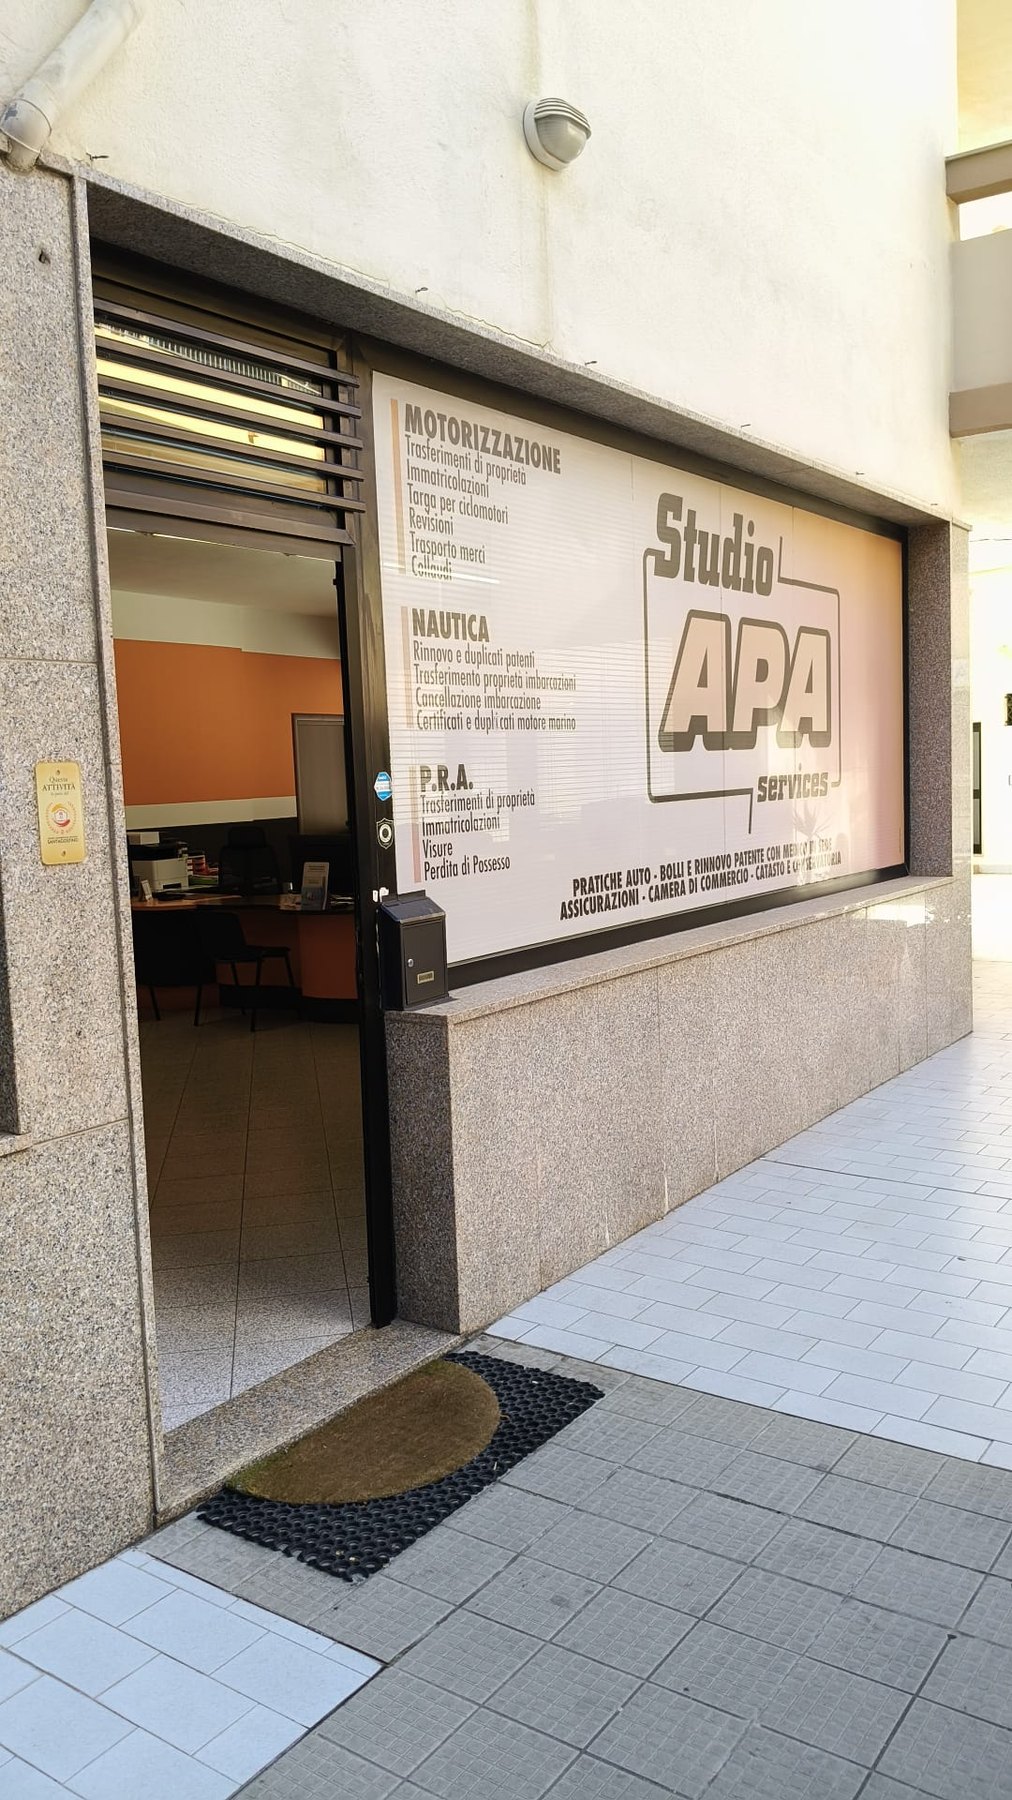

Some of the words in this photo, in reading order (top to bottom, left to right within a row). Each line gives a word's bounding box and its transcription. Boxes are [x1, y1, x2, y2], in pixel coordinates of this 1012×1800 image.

[405, 404, 561, 474] MOTORIZZAZIONE
[405, 435, 471, 471] Trasferimenti
[474, 453, 483, 473] di
[486, 461, 526, 485] proprietà
[407, 459, 489, 498] Immatricolazioni
[407, 483, 436, 514] Targa
[440, 497, 455, 515] per
[459, 496, 509, 524] ciclomotori
[409, 507, 454, 536] Revisioni
[409, 531, 457, 561] Trasporto
[460, 545, 486, 564] merci
[654, 492, 773, 597] Studio
[411, 555, 452, 580] Collaudi
[412, 608, 490, 643] NAUTICA
[413, 640, 453, 664] Rinnovo
[456, 650, 462, 664] e
[465, 643, 503, 669] duplicati
[506, 651, 535, 674] patenti
[414, 663, 481, 687] Trasferimento
[484, 670, 523, 694] proprietà
[525, 670, 577, 691] imbarcazioni
[657, 609, 831, 752] APA
[416, 687, 482, 709] Cancellazione
[484, 687, 541, 710] imbarcazione
[417, 710, 463, 731] Certificati
[466, 717, 472, 730] e
[474, 711, 514, 735] duplicati
[518, 714, 546, 731] motore
[549, 714, 576, 730] marino
[420, 763, 474, 792] P.R.A.
[757, 762, 828, 802] services
[420, 792, 484, 815] Trasferimenti
[486, 788, 495, 809] di
[497, 789, 535, 814] proprietà
[422, 811, 501, 837] Immatricolazioni
[422, 839, 453, 859] Visure
[424, 858, 458, 881] Perdita
[461, 855, 470, 876] di
[473, 855, 511, 874] Possesso
[572, 871, 622, 897] PRATICHE
[625, 867, 651, 888] AUTO
[660, 862, 685, 882] BOLLI
[687, 860, 692, 876] E
[694, 854, 732, 875] RINNOVO
[734, 848, 765, 869] PATENTE
[766, 844, 781, 862] CON
[783, 841, 808, 859] MEDCO
[560, 889, 640, 921] ASSICURAZIONI
[648, 881, 686, 903] CAMERA
[688, 877, 698, 893] DI
[700, 868, 749, 892] COMMERCIO
[755, 860, 785, 881] CATASTO
[787, 859, 791, 875] E
